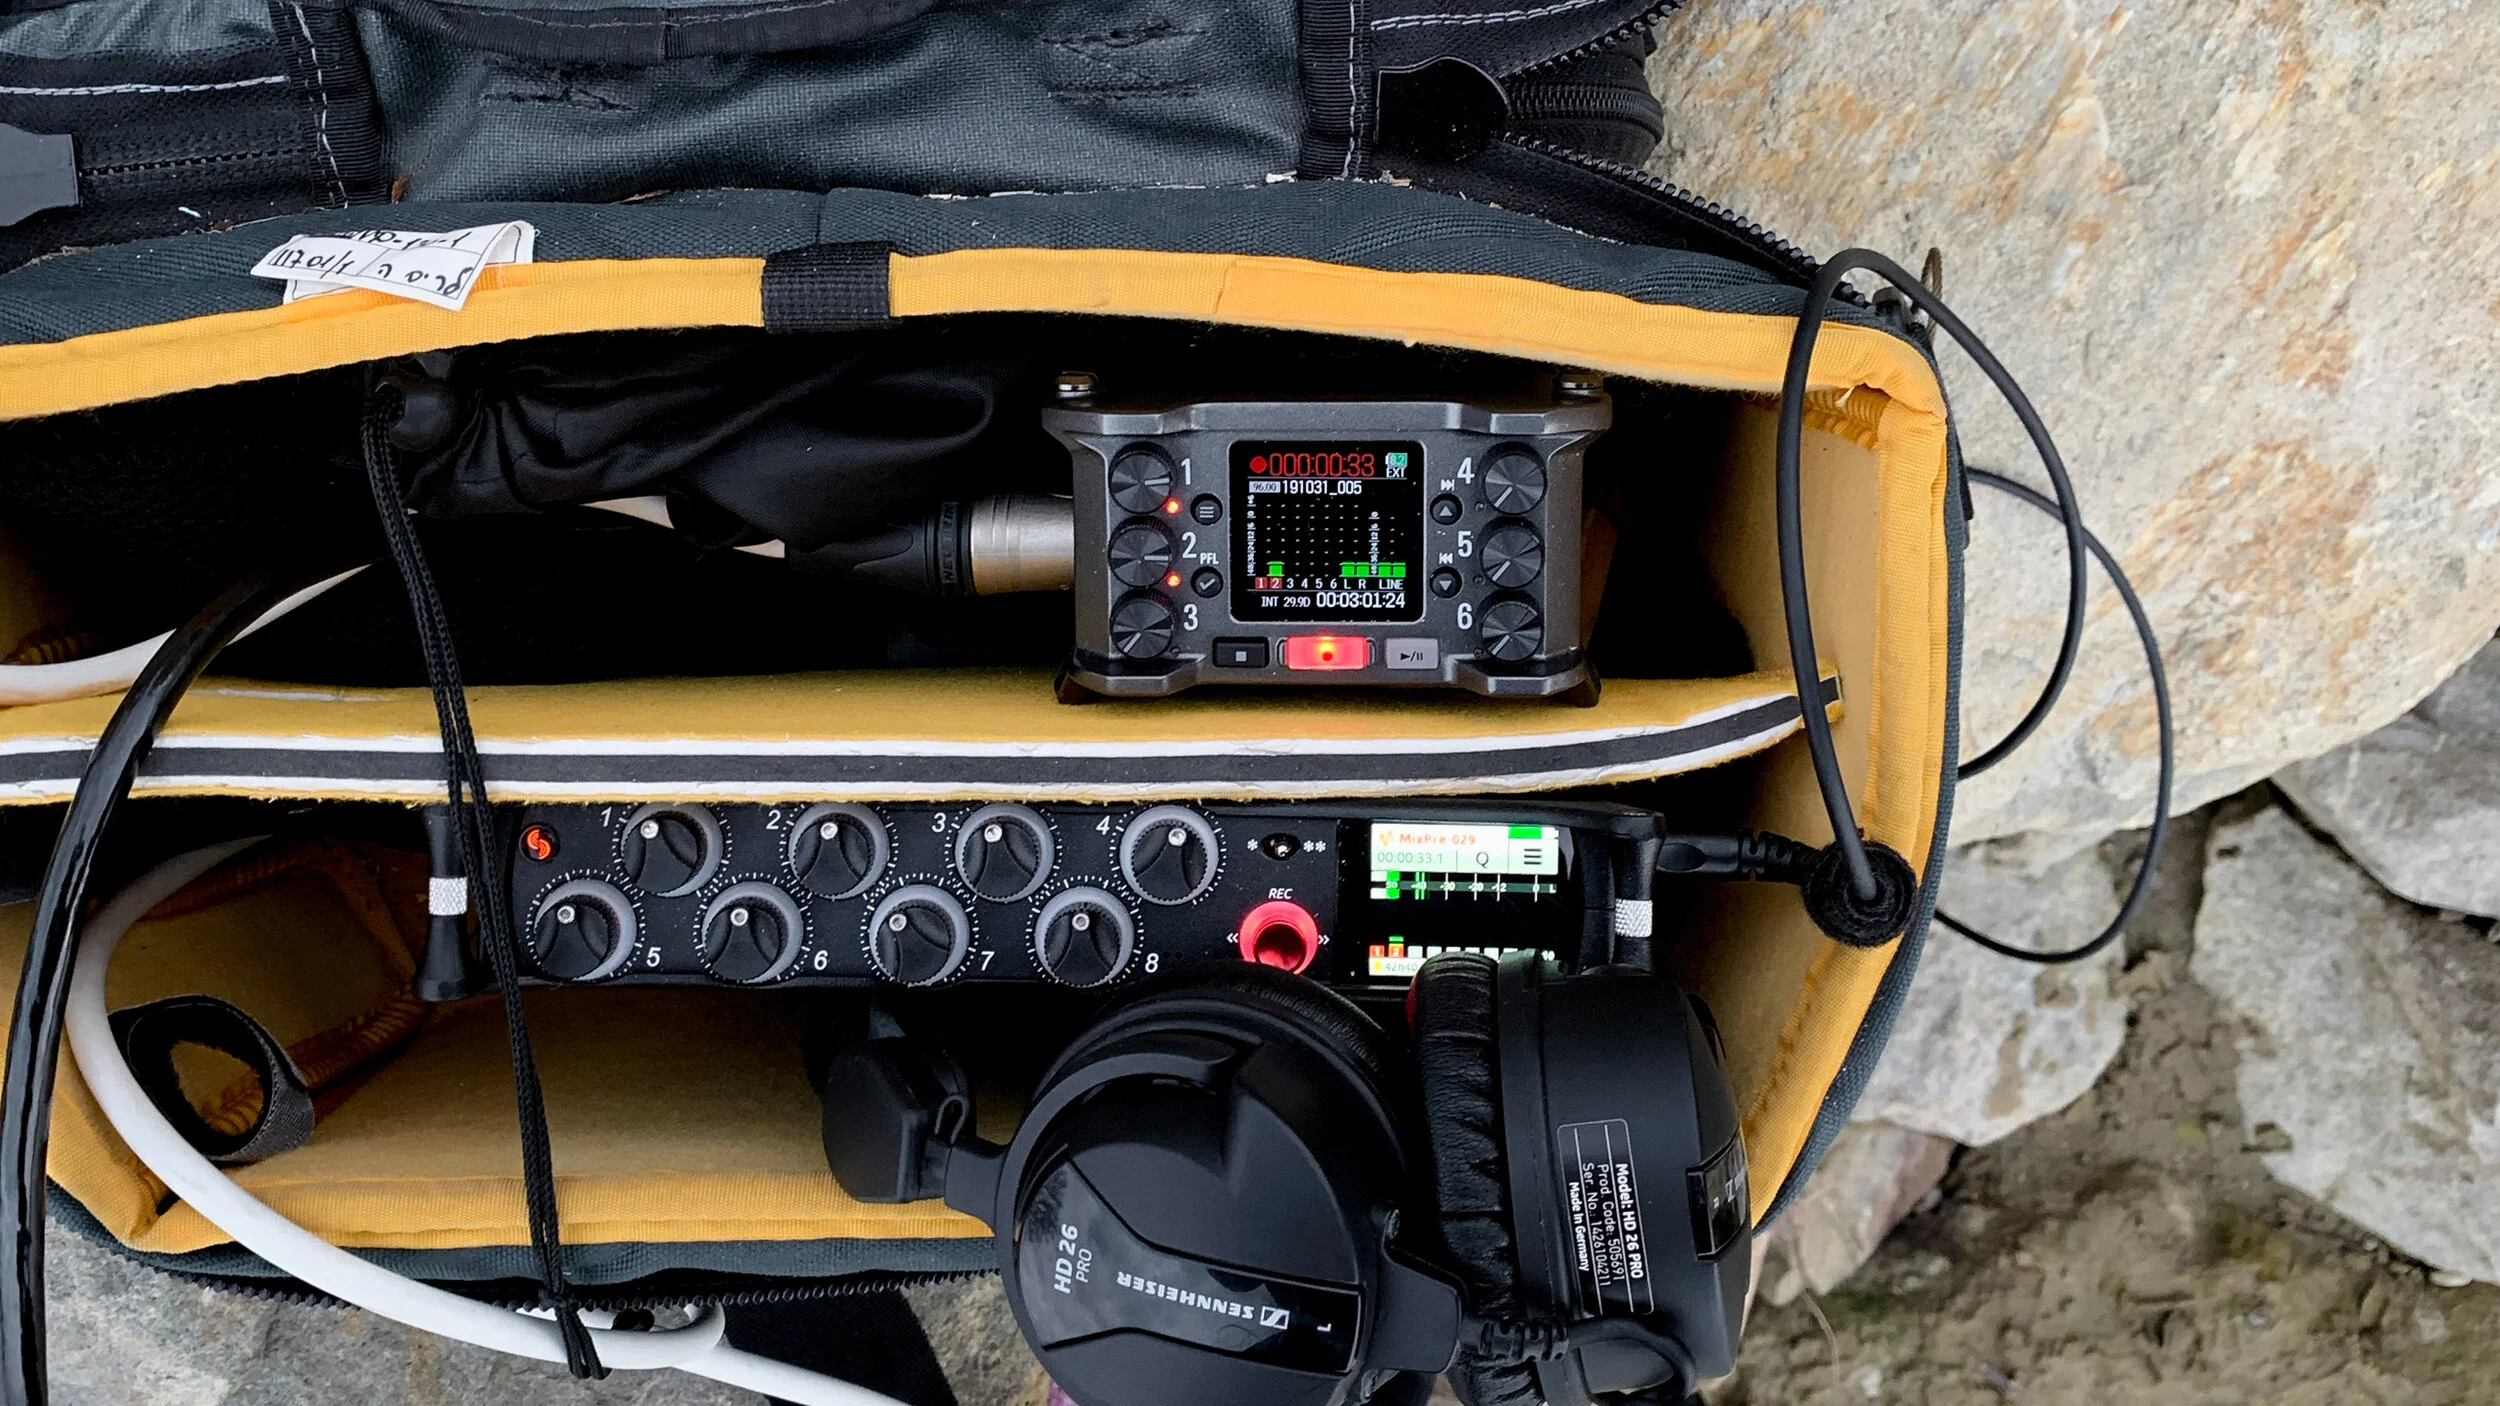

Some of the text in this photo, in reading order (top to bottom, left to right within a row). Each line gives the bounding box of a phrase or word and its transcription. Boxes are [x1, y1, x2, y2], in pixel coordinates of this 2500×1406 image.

[1181, 459, 1192, 485] 1
[1269, 453, 1375, 477] 000:00:33
[1386, 467, 1405, 478] EXT
[1457, 458, 1475, 483] 4
[1282, 480, 1362, 495] 191031_005
[1182, 533, 1196, 559] 2
[1458, 531, 1473, 557] 5
[1200, 552, 1219, 566] PFL
[1258, 578, 1404, 590] 1 2 3 4 5 6 L R LINE
[1261, 596, 1279, 607] INT
[1316, 592, 1405, 608] 00:03:01:24
[1183, 604, 1199, 630] 3
[1457, 603, 1472, 630] 6
[601, 806, 612, 827] 1
[766, 810, 782, 830] 2
[932, 813, 946, 832] 3
[1096, 815, 1112, 835] 4
[1268, 888, 1293, 901] REC
[646, 946, 662, 967] 5
[814, 950, 829, 970] 6
[981, 951, 996, 971] 7
[1144, 953, 1159, 973] 8
[1569, 1182, 1582, 1211] Made
[1583, 1163, 1595, 1189] Ser.
[1591, 1222, 1611, 1286] 1426104211
[1598, 1164, 1626, 1280] Prod. Code: 505691
[1616, 1163, 1644, 1279] Model: HD 26 PRO
[1054, 1224, 1078, 1294] HD 26
[1574, 1225, 1590, 1272] Germany
[1076, 1248, 1092, 1283] PRO
[1116, 1270, 1254, 1320] SENNHEISER
[1316, 1322, 1332, 1332] L
